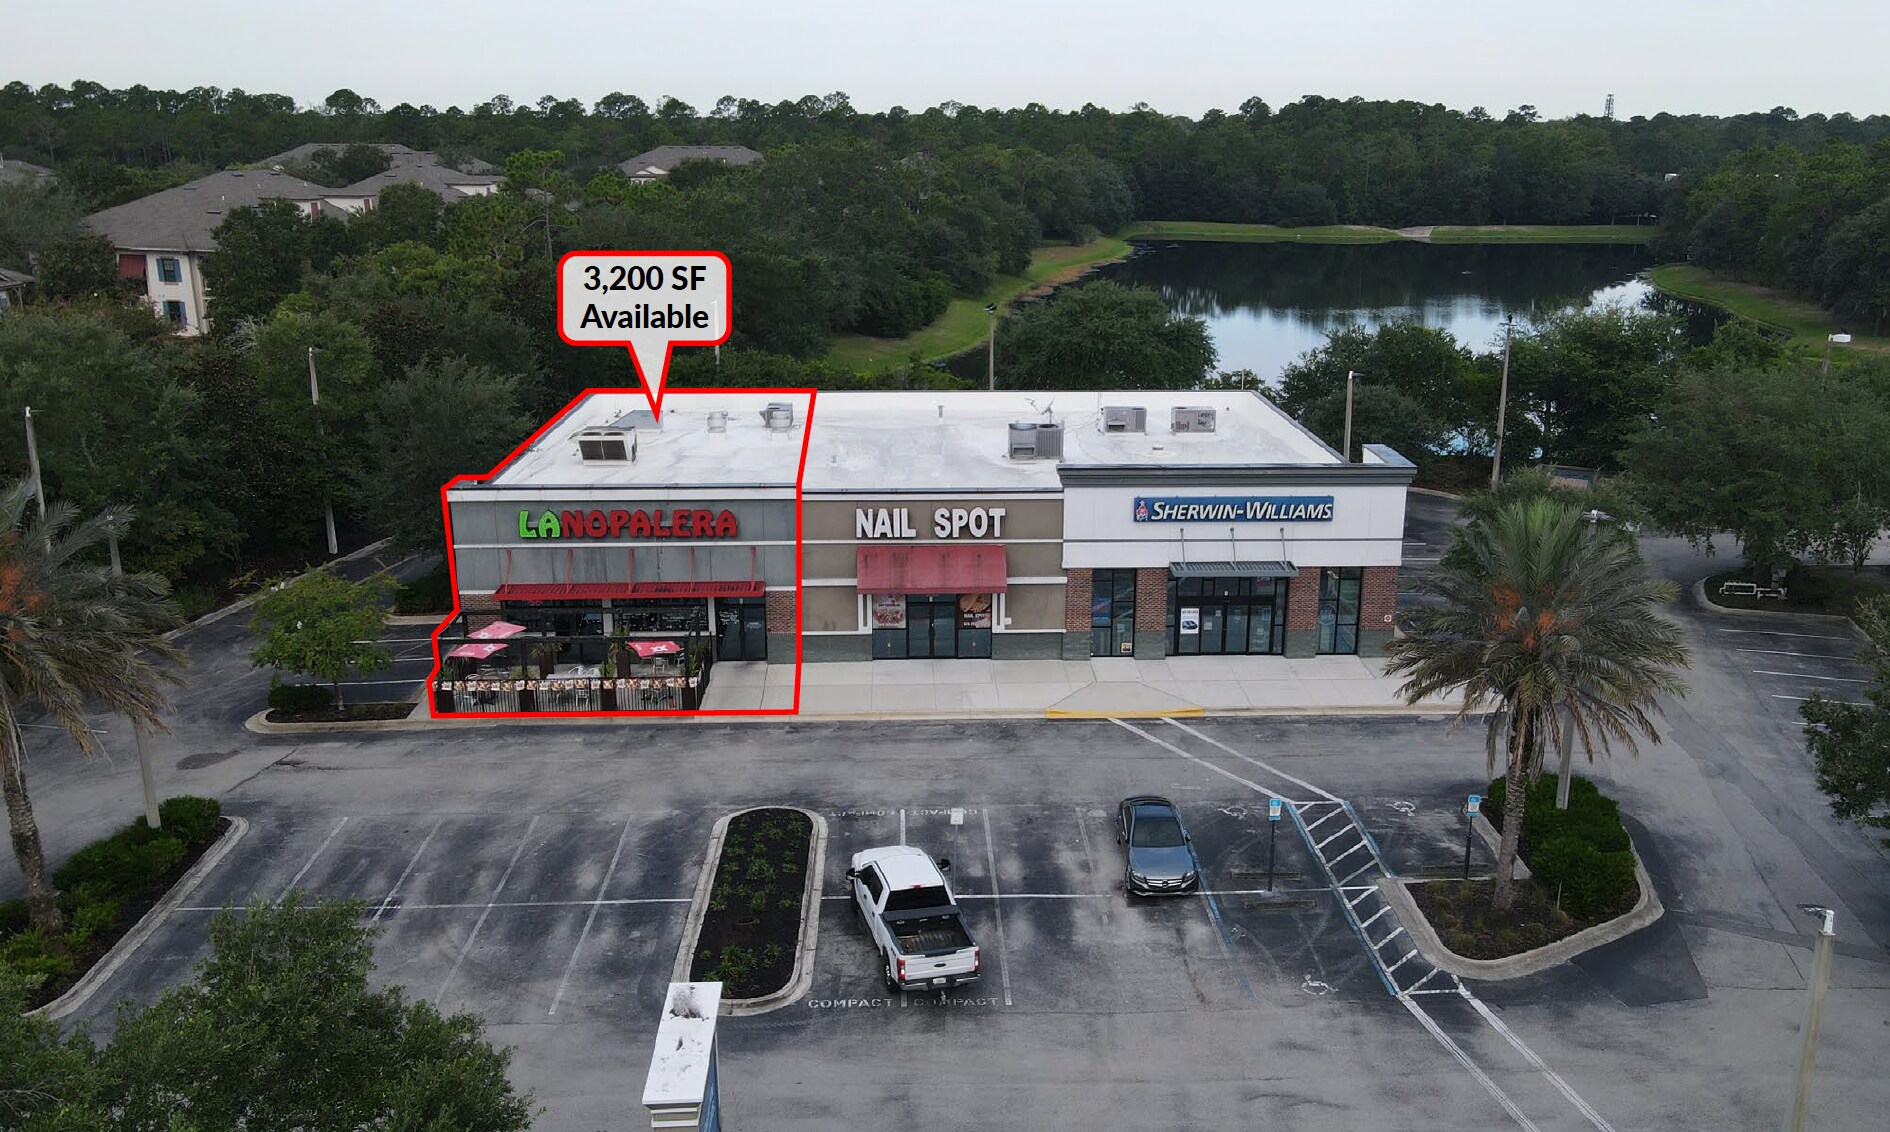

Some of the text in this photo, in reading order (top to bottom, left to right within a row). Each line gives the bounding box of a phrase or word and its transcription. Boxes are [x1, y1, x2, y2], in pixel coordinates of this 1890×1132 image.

[1151, 501, 1332, 520] SHERWIN-WILLIAMS
[855, 507, 1006, 538] NAIL SPOT
[808, 998, 894, 1009] COMPACT
